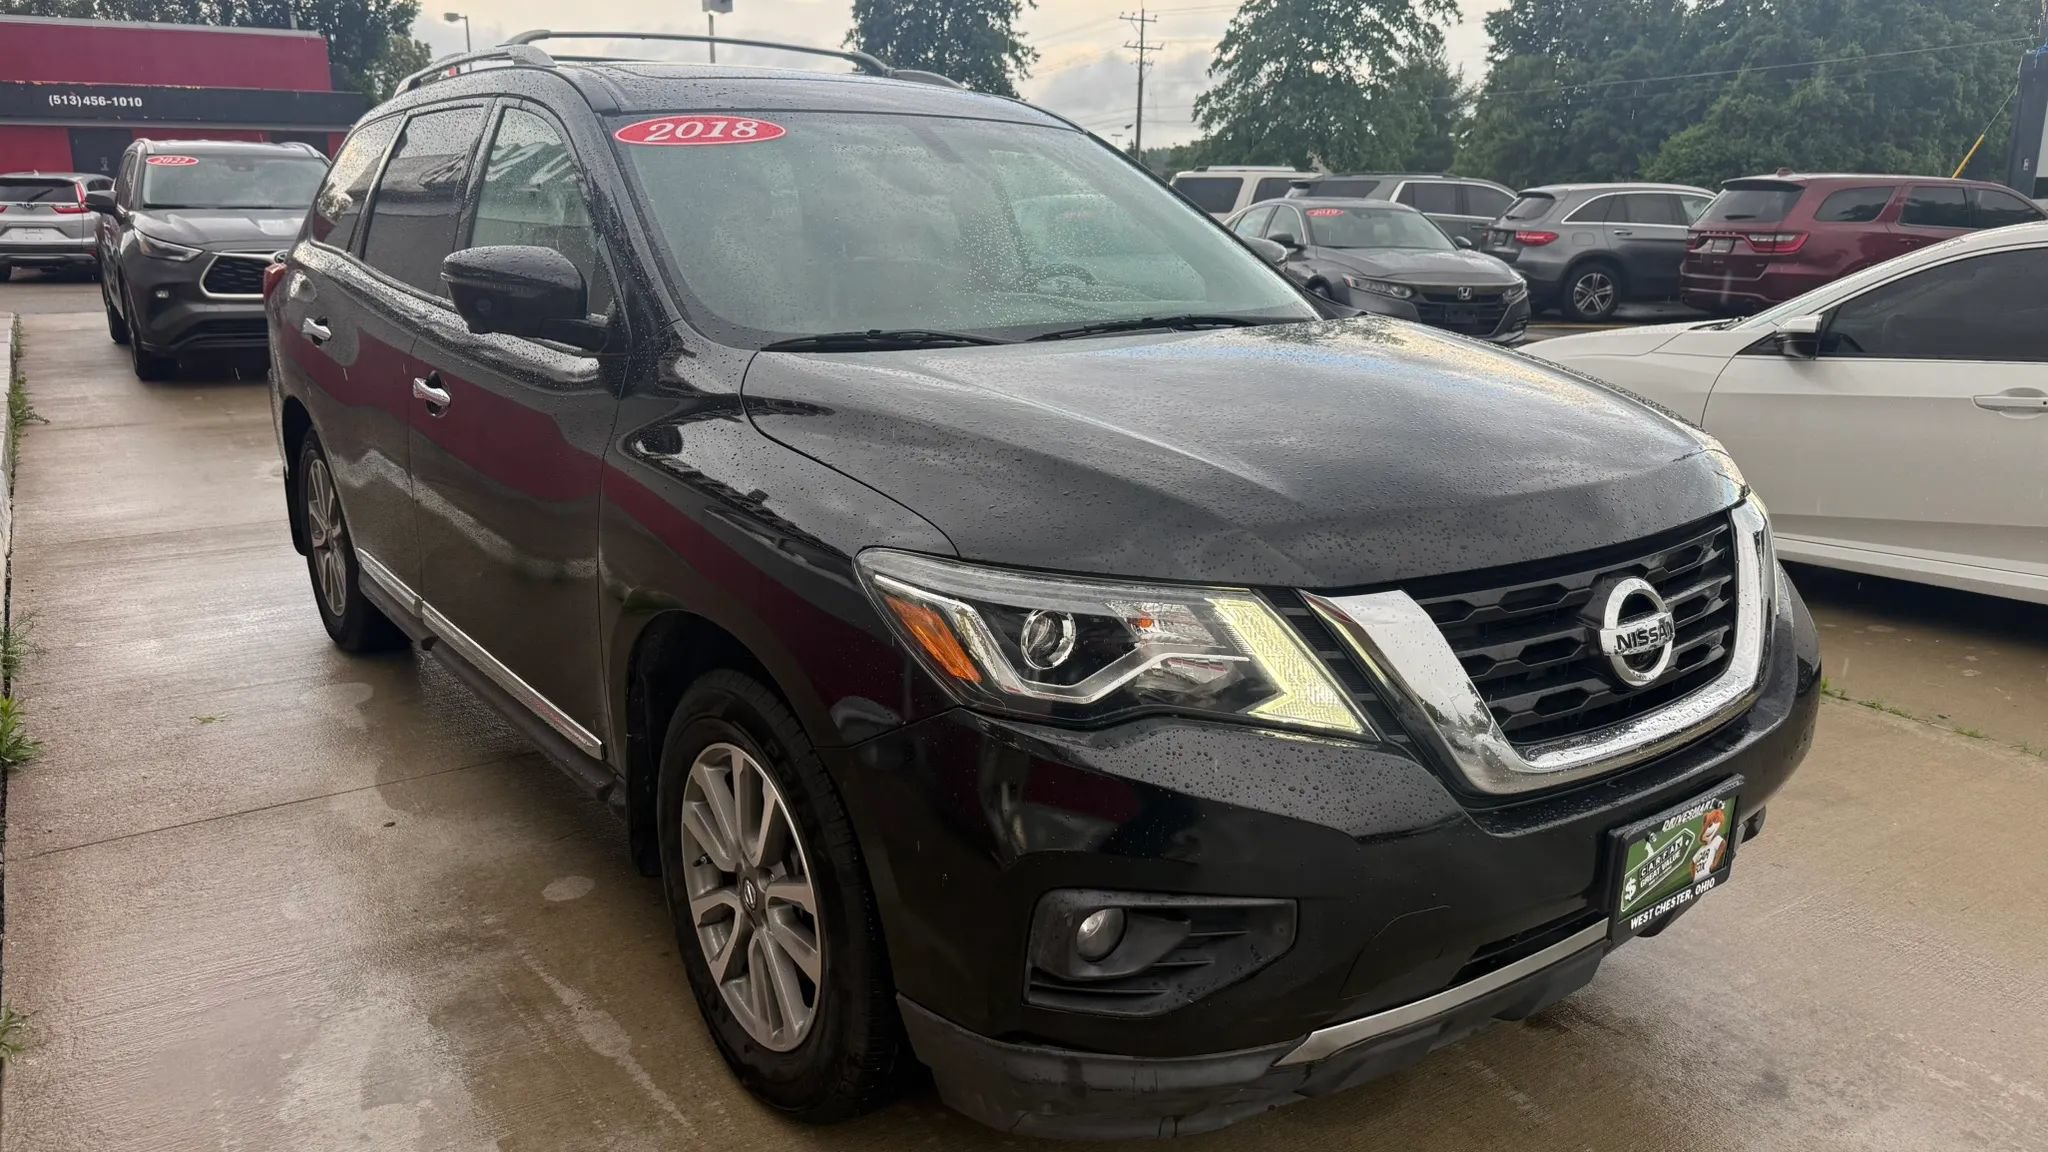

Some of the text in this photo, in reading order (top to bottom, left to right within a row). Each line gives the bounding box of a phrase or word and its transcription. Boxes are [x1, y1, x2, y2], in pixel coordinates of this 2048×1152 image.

[48, 95, 143, 108] (513)456-1010
[643, 120, 759, 142] 2018
[1616, 621, 1674, 650] NISSAN
[1630, 878, 1715, 930] WEST CHESTER, OHIO
